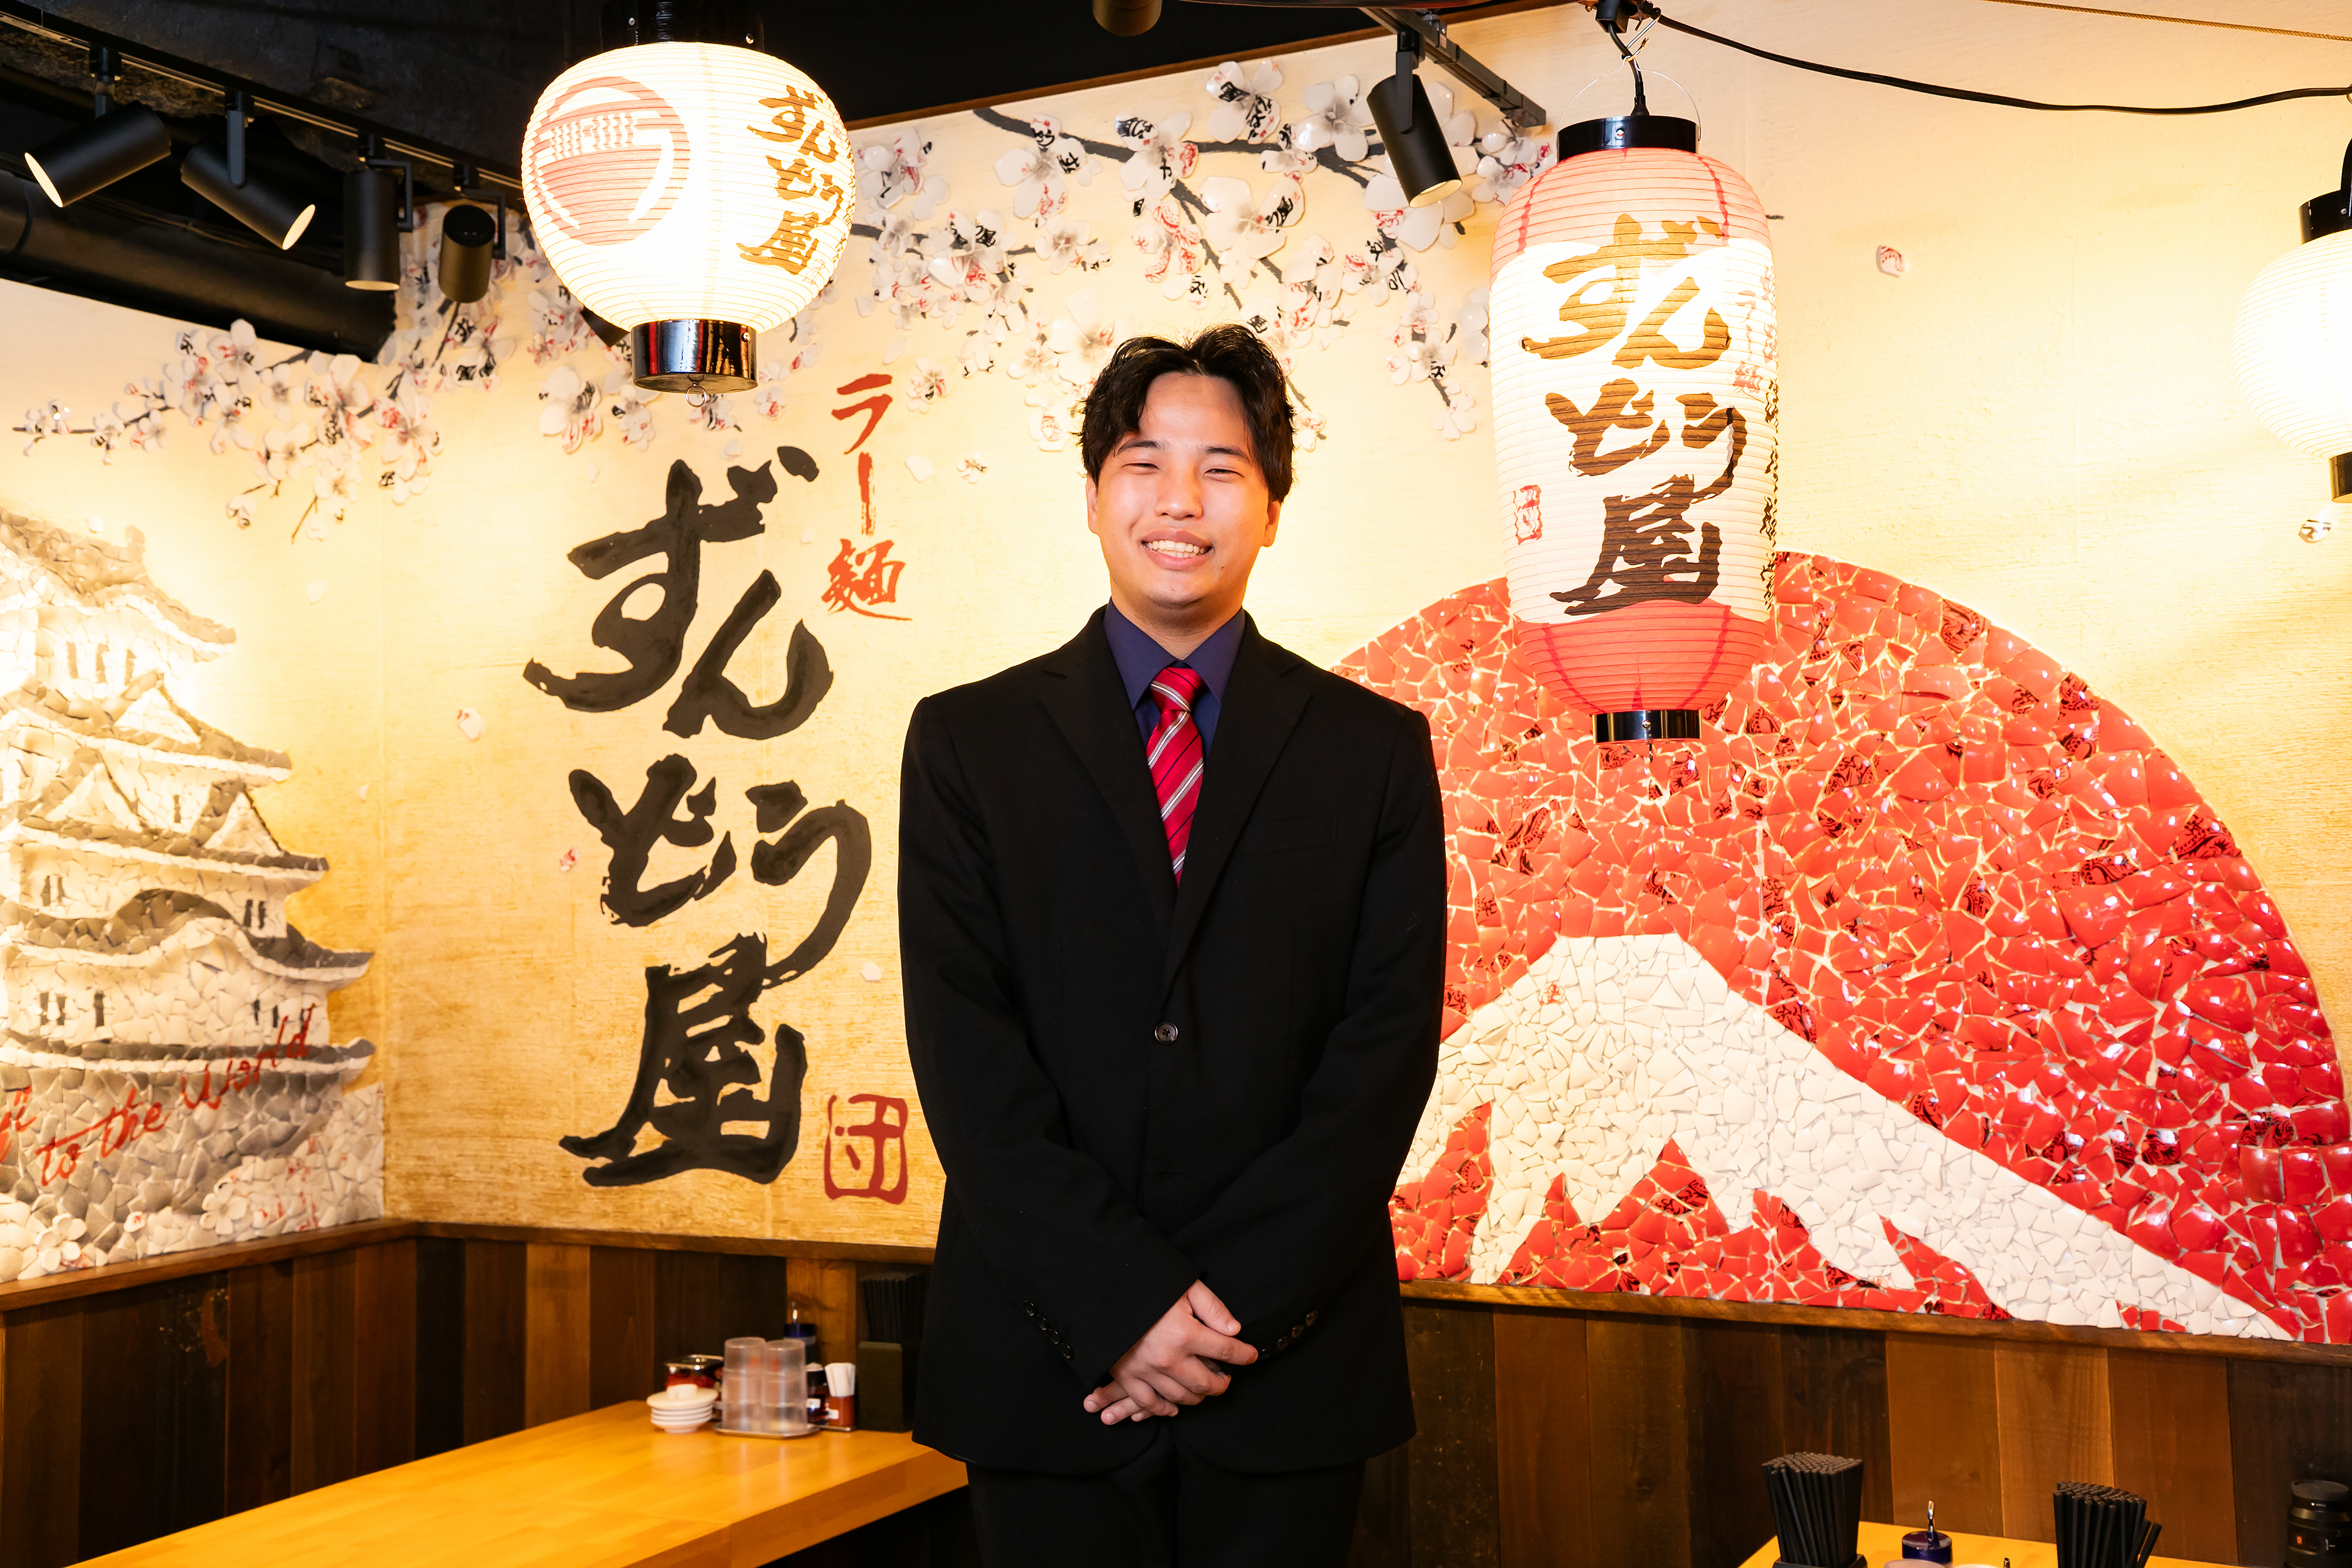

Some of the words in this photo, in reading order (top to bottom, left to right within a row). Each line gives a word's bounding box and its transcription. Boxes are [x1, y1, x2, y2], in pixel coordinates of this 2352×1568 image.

[736, 84, 844, 276] ずんどう屋
[822, 374, 912, 620] ラー麺
[1521, 213, 1747, 617] ずんどう屋
[523, 446, 872, 1187] ずんどう屋
[34, 1136, 82, 1186] to
[100, 1087, 169, 1158] the
